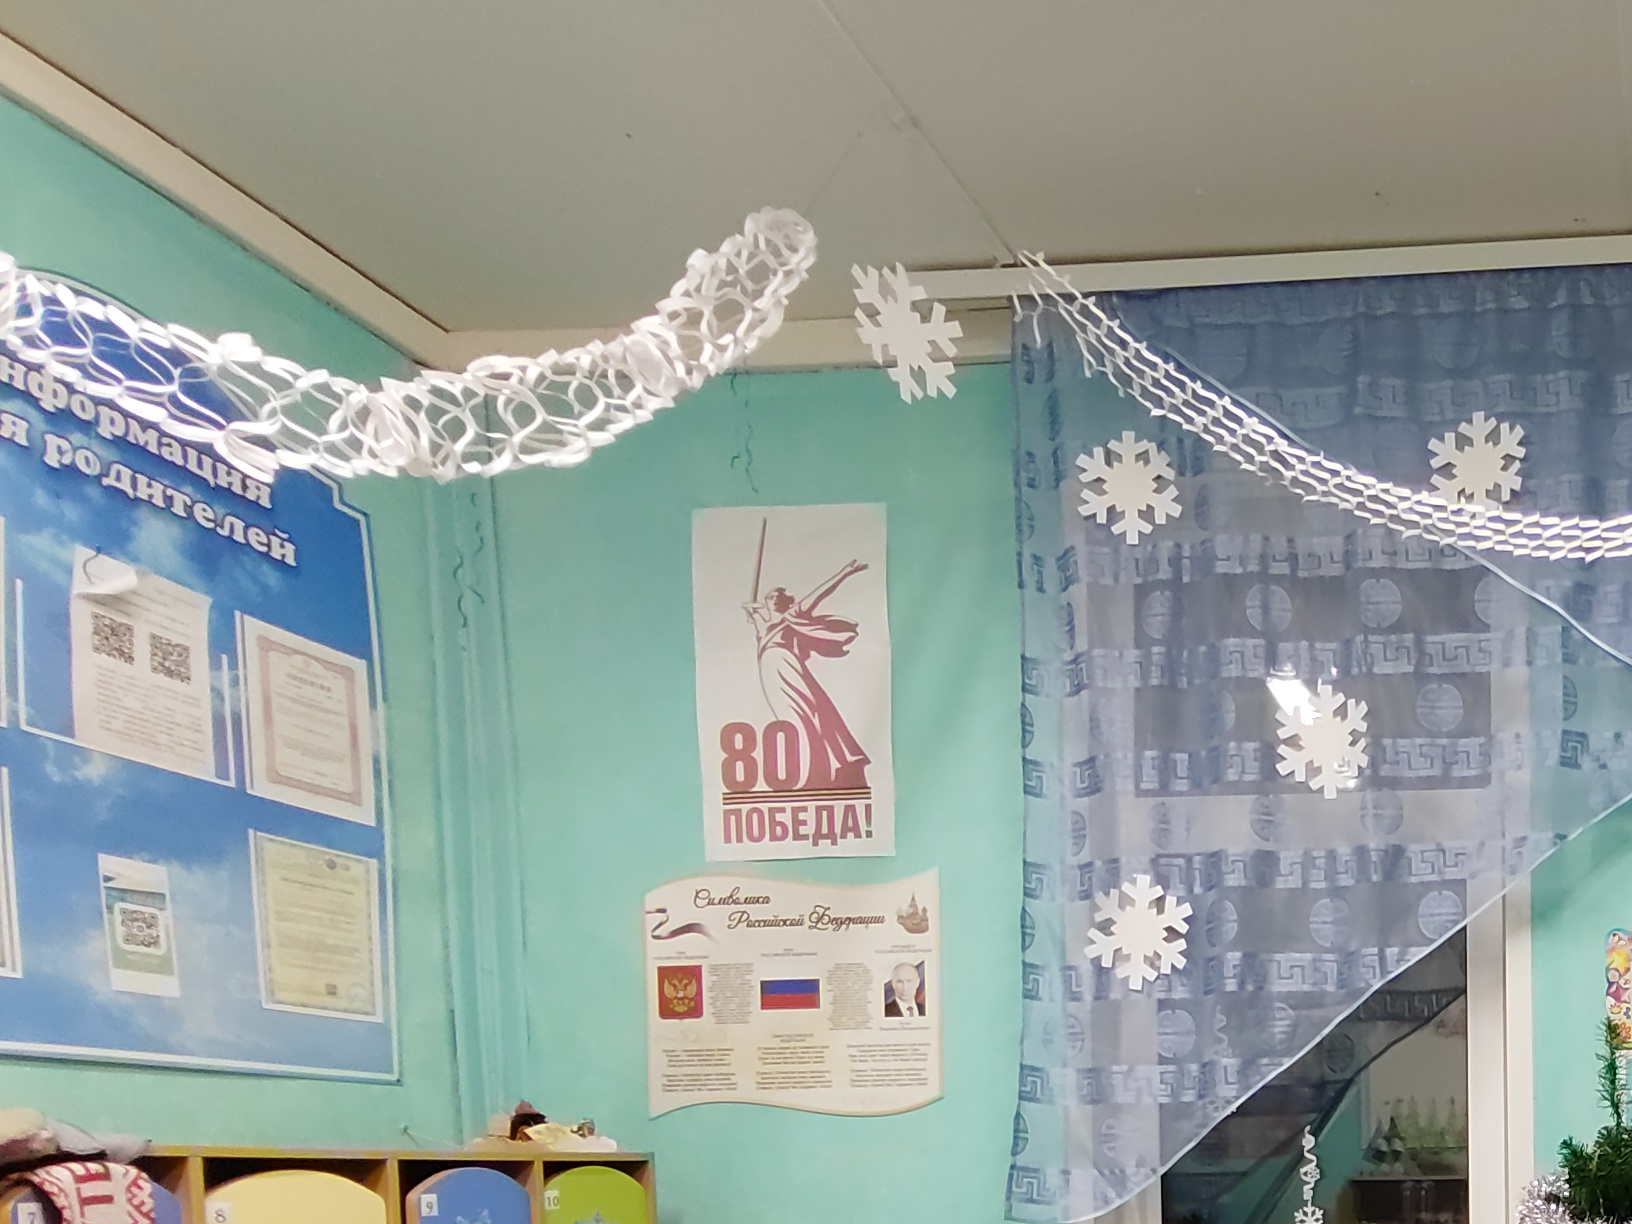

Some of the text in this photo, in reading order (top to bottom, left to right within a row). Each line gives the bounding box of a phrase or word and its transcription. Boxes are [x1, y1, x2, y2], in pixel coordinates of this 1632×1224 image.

[44, 433, 297, 566] родителей
[720, 720, 800, 791] 80
[722, 804, 873, 846] ПОБЕДА!
[694, 887, 771, 908] Символика
[728, 905, 886, 931] Российской Федерации
[425, 1200, 434, 1215] 9
[546, 1195, 559, 1208] 10
[214, 1208, 226, 1224] 8
